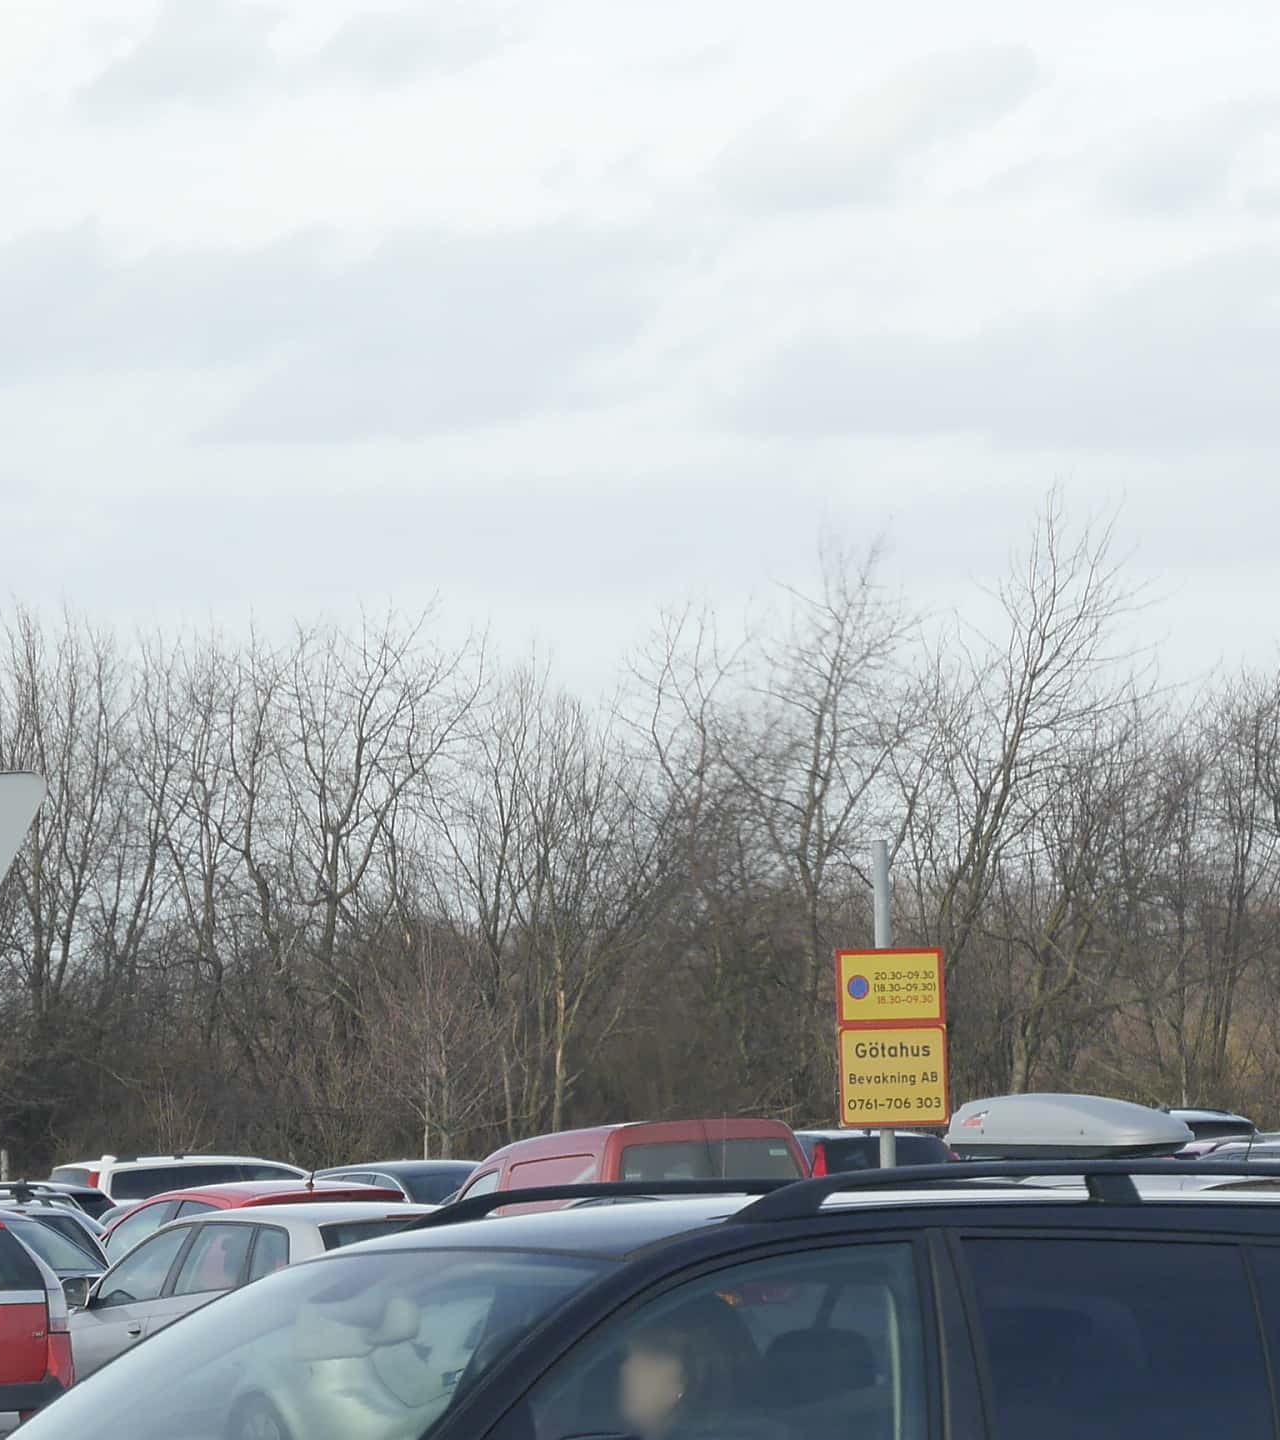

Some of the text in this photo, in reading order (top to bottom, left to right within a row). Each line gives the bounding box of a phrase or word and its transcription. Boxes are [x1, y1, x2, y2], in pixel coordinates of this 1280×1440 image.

[855, 1042, 931, 1058] Götahus
[849, 1071, 938, 1086] Bevakning AB
[848, 1097, 941, 1110] 0761-706 303
